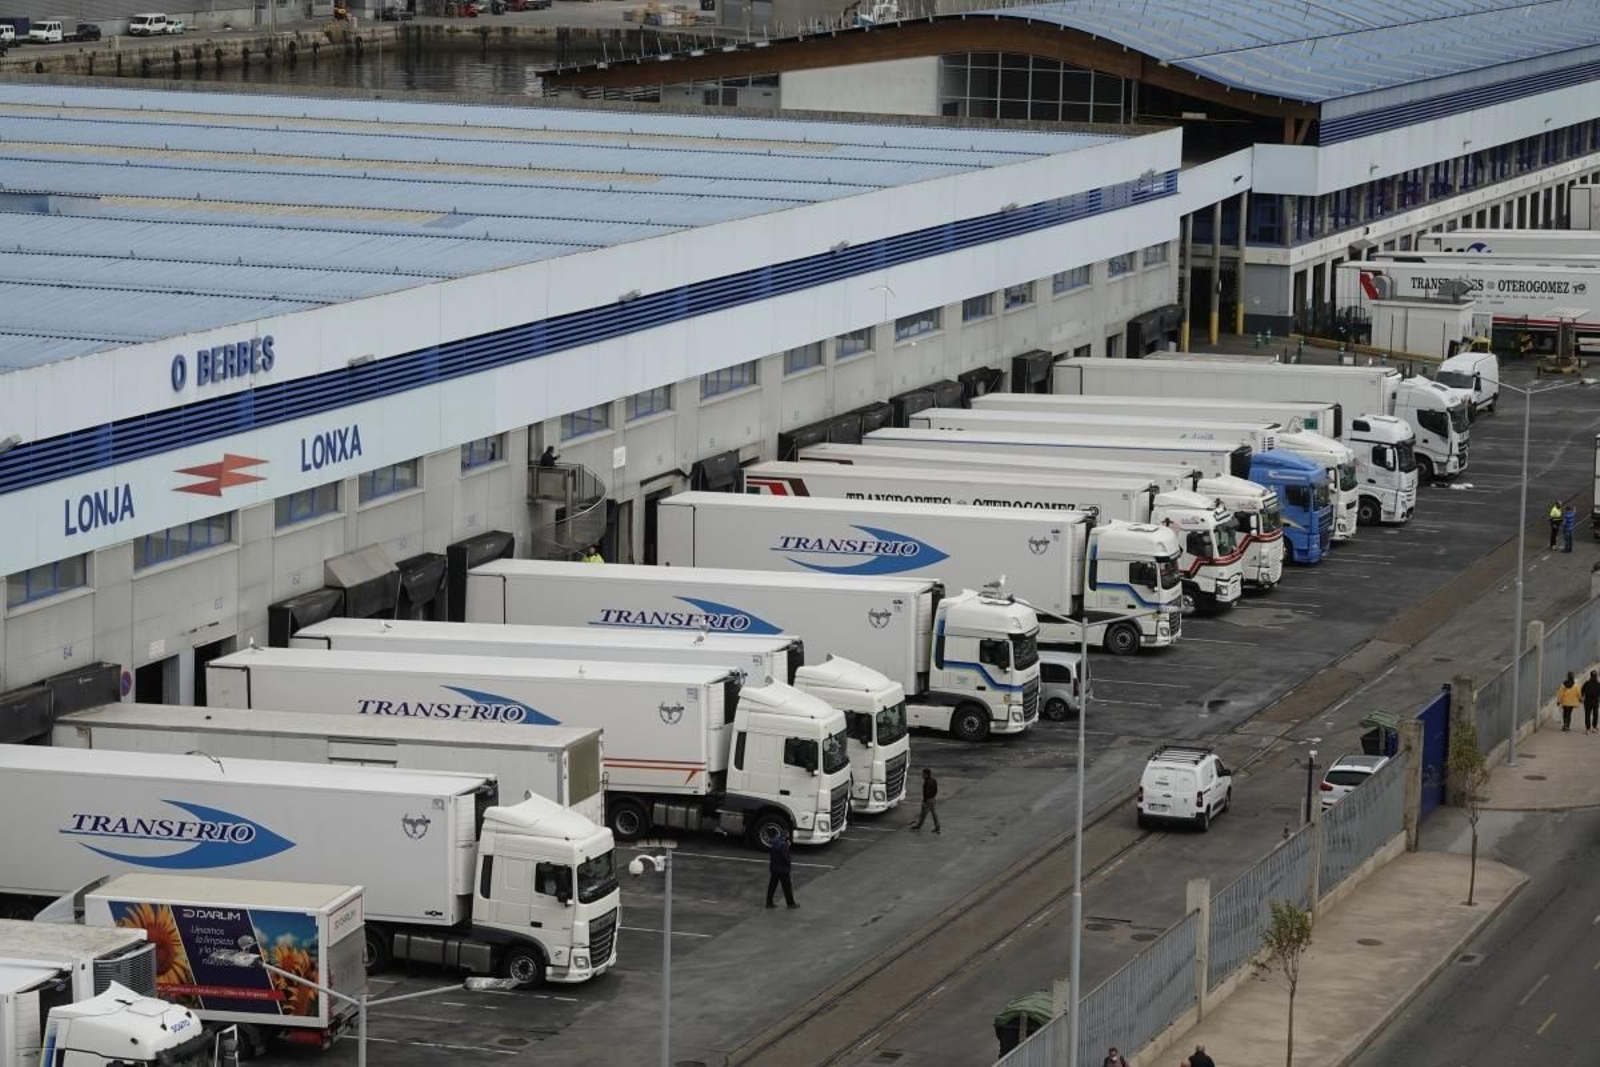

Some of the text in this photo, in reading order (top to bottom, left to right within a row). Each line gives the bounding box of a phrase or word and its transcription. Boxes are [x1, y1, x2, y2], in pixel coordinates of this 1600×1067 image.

[1411, 276, 1570, 294] TRANSES OTEROGOMEZ
[171, 335, 275, 393] O BERBES
[301, 424, 362, 472] LONXA
[65, 484, 135, 536] LONJA
[780, 535, 920, 557] TRANSFRIO
[600, 608, 749, 631] TRANSFRIO
[358, 699, 527, 723] TRANSFRIO
[72, 813, 256, 843] TRANSFRIO
[196, 909, 241, 921] DARLIM
